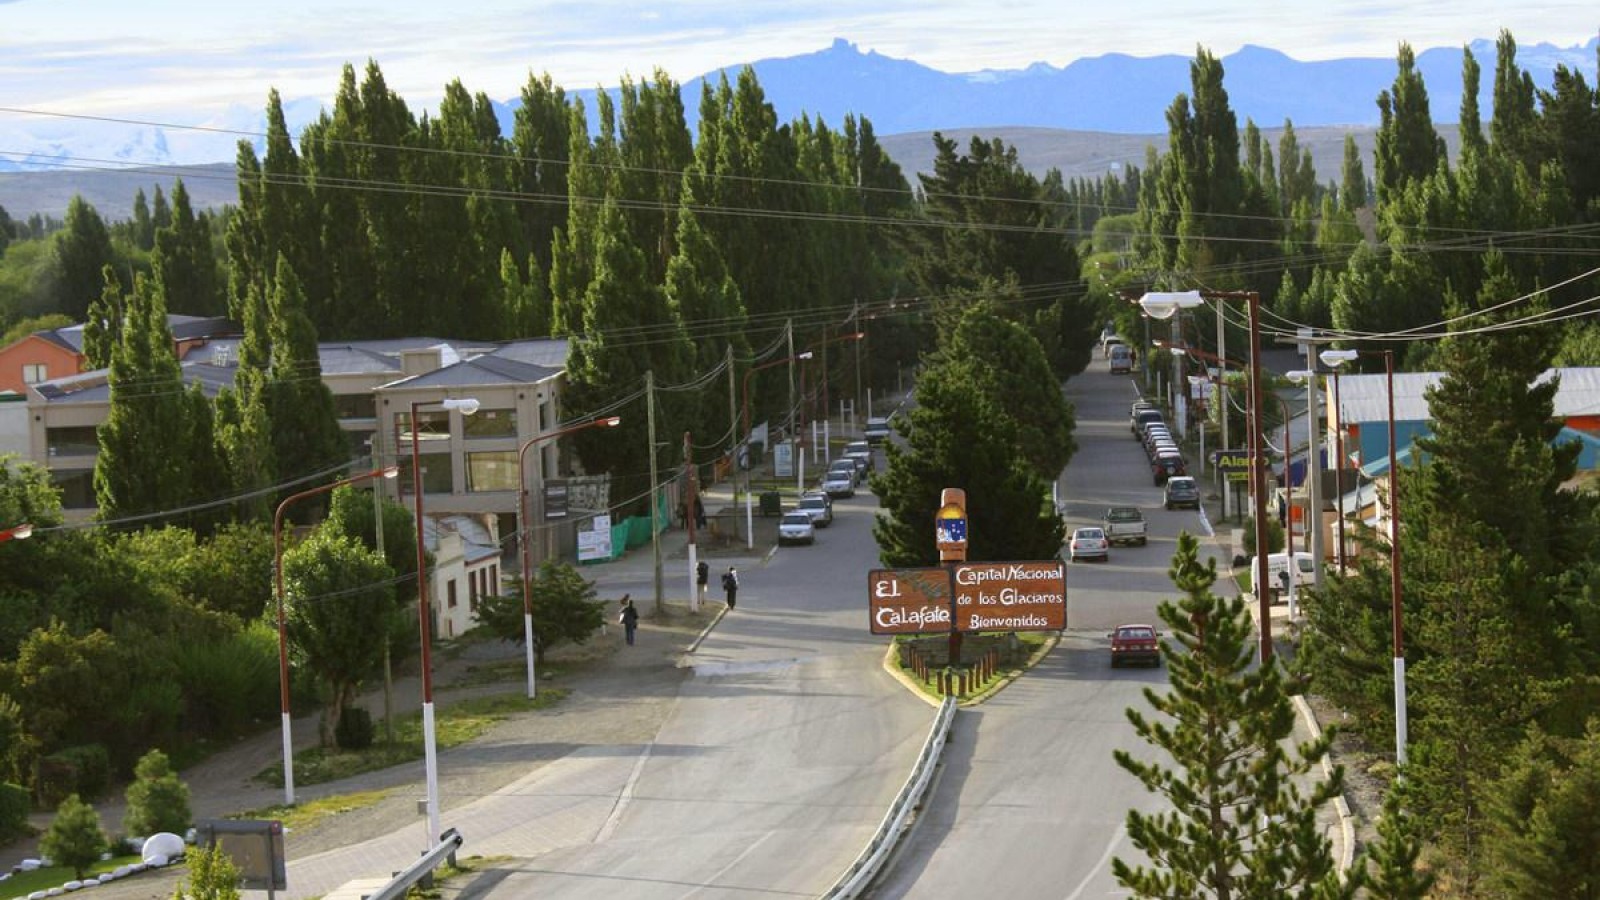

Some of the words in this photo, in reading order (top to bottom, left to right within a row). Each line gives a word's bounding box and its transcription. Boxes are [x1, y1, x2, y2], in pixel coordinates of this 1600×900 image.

[956, 566, 1006, 585] Capital
[1007, 564, 1063, 581] Nacional
[957, 593, 972, 605] de
[979, 591, 997, 605] los
[1000, 587, 1063, 606] Glaciares
[969, 614, 1048, 630] Bienvenidos
